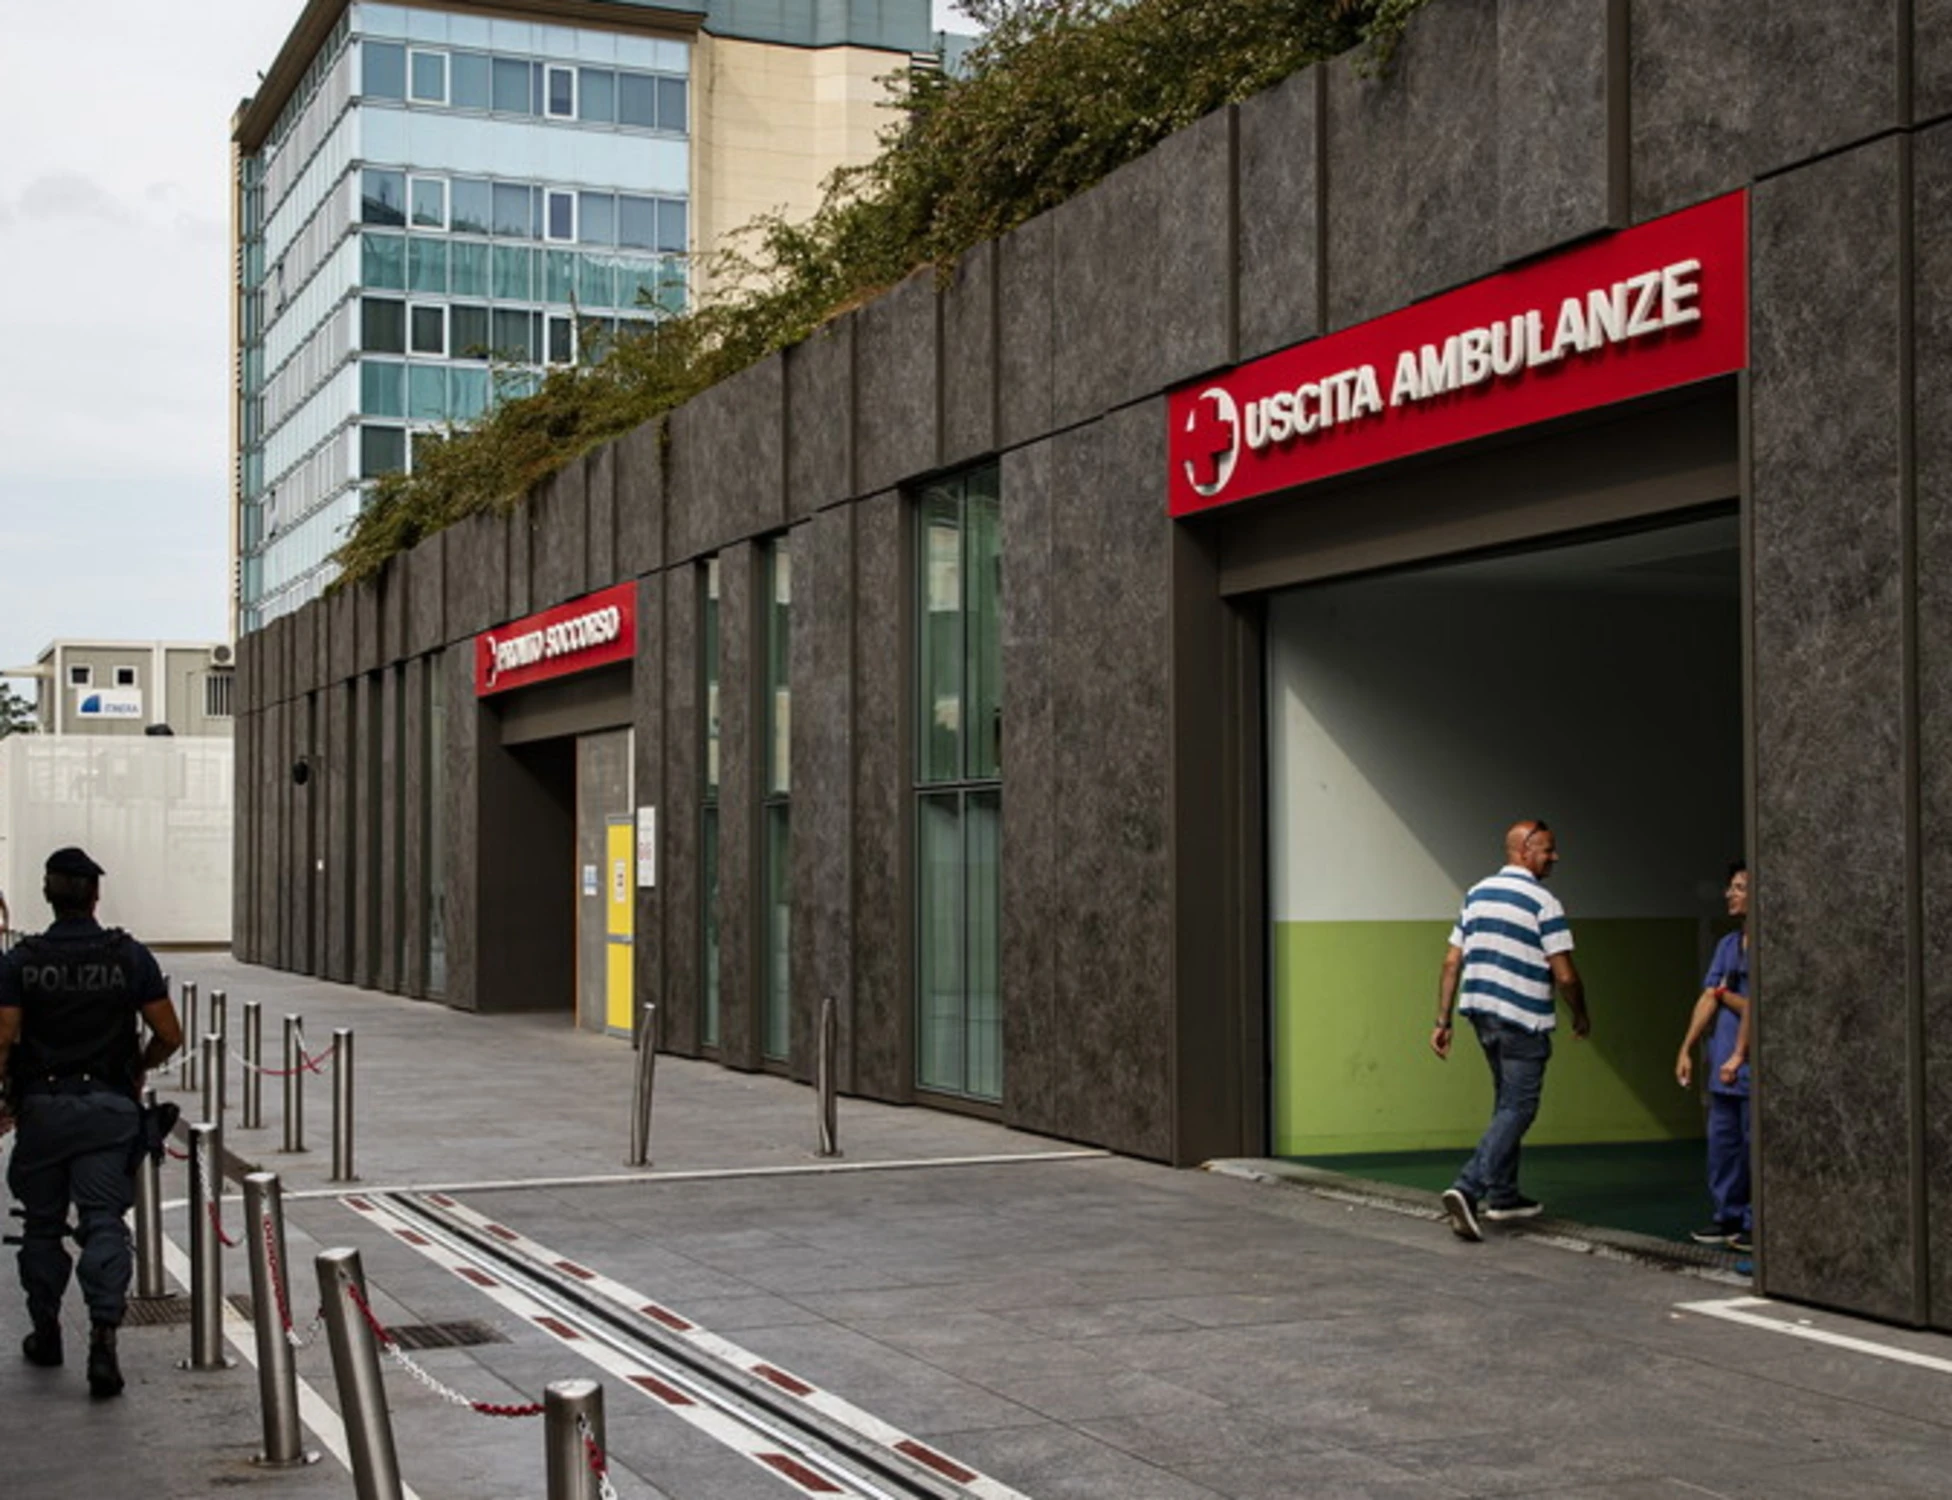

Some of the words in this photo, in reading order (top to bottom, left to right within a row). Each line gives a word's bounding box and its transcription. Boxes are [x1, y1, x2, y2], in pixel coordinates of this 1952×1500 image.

[1244, 364, 1383, 450] USCITA
[1390, 258, 1701, 407] AMBULANZE
[496, 630, 544, 672] PRONTO
[546, 605, 620, 658] SOCCORSO
[22, 964, 127, 991] POLIZIA
